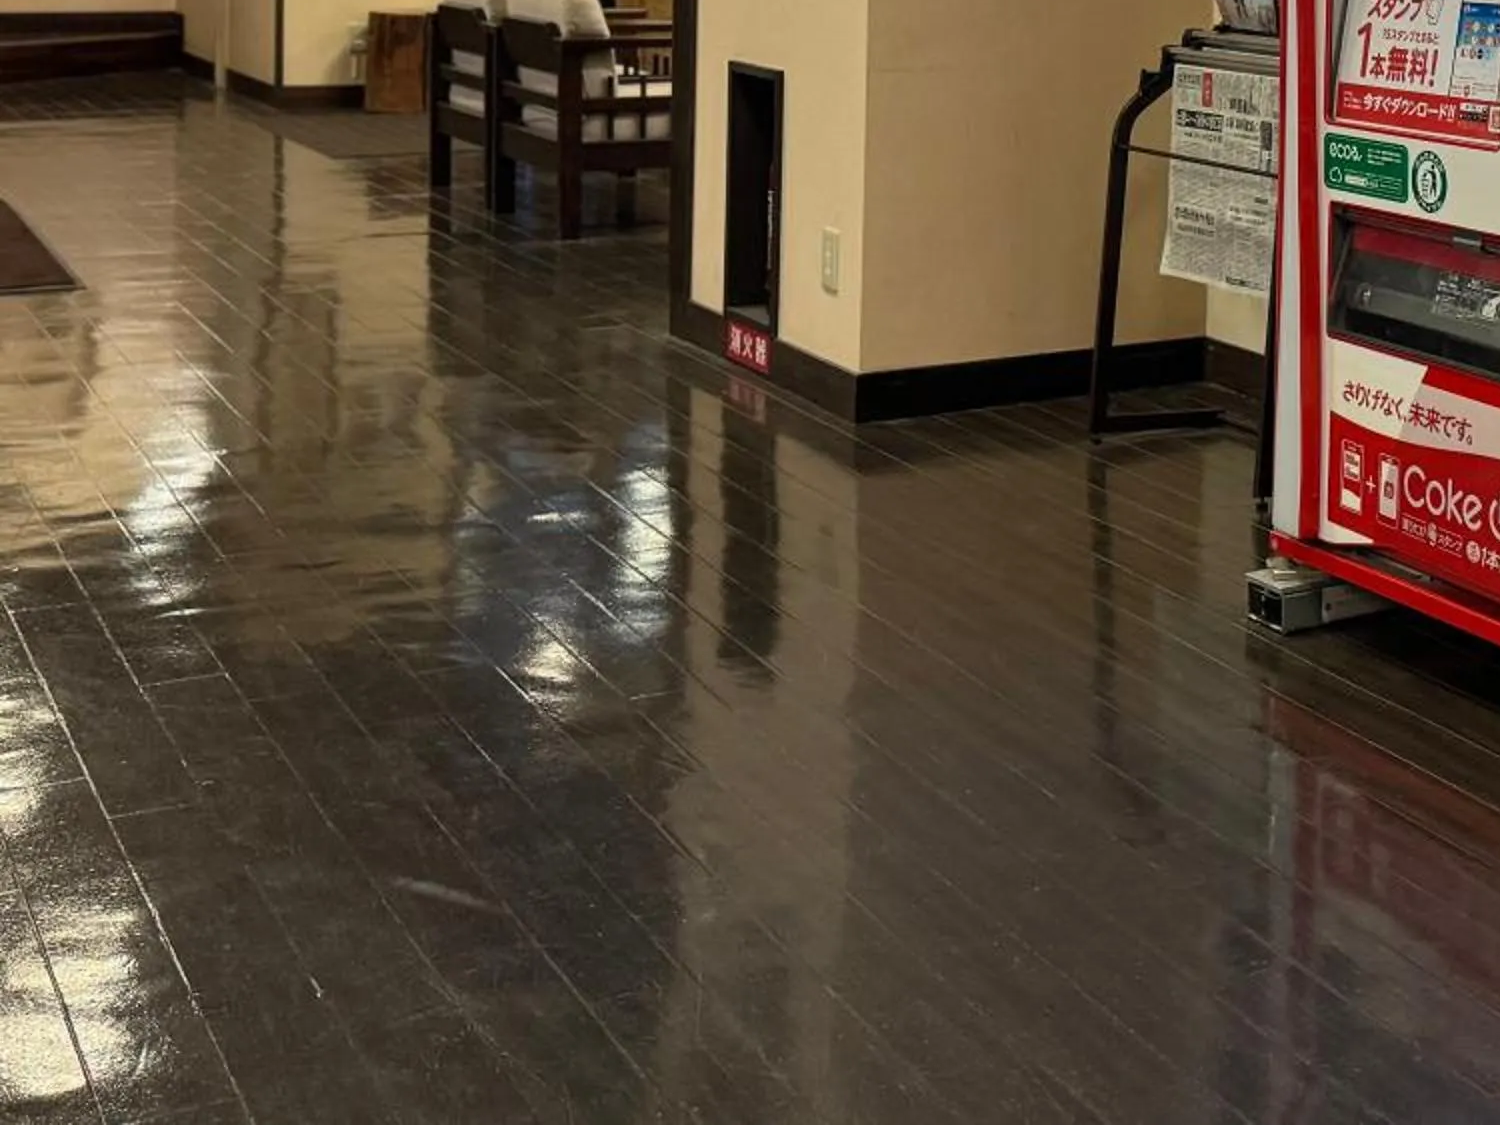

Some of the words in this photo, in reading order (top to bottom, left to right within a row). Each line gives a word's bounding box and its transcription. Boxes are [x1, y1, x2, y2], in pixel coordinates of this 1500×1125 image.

[1357, 22, 1439, 87] 1本無料!
[730, 326, 768, 366] 消火器
[1403, 465, 1483, 531] Coke
